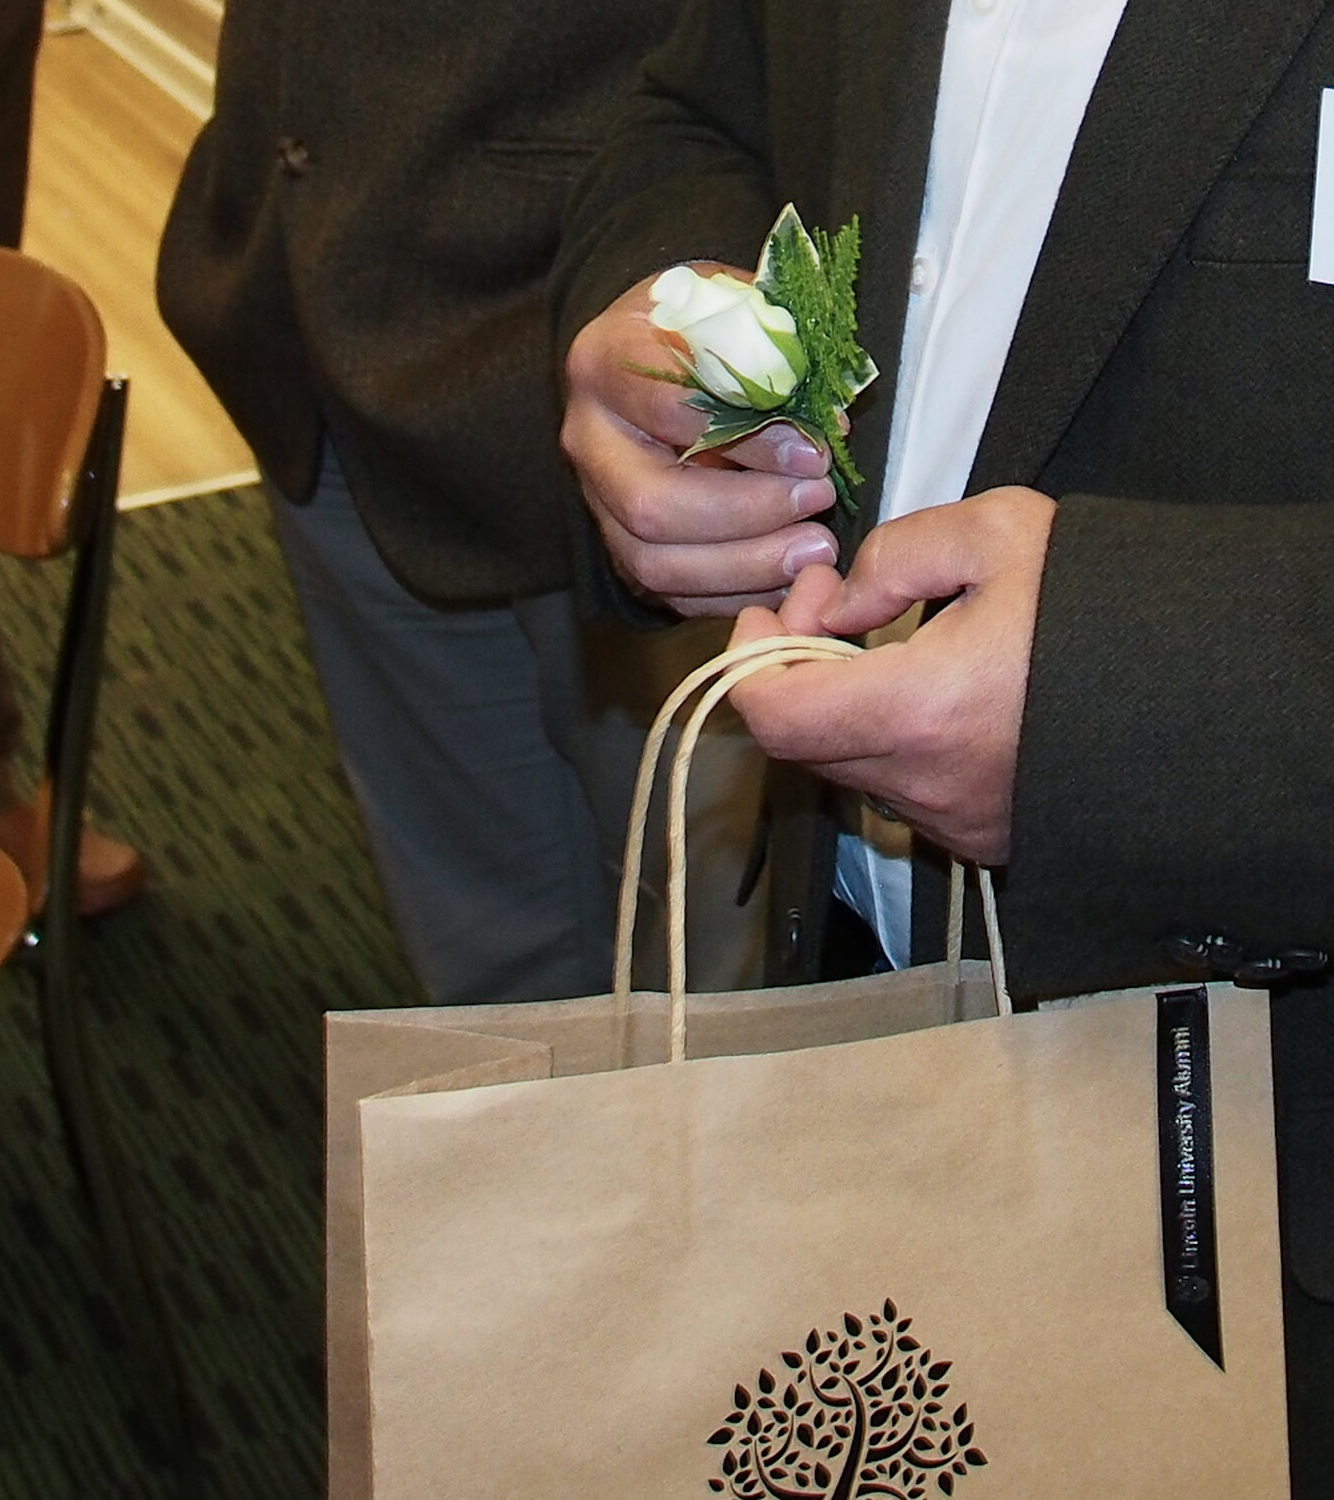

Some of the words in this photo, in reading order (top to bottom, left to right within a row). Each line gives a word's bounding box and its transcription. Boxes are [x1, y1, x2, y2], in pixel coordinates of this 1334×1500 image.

[1171, 1025, 1193, 1097] Alumni
[1175, 1100, 1197, 1194] University
[1180, 1197, 1197, 1270] Lincoln
